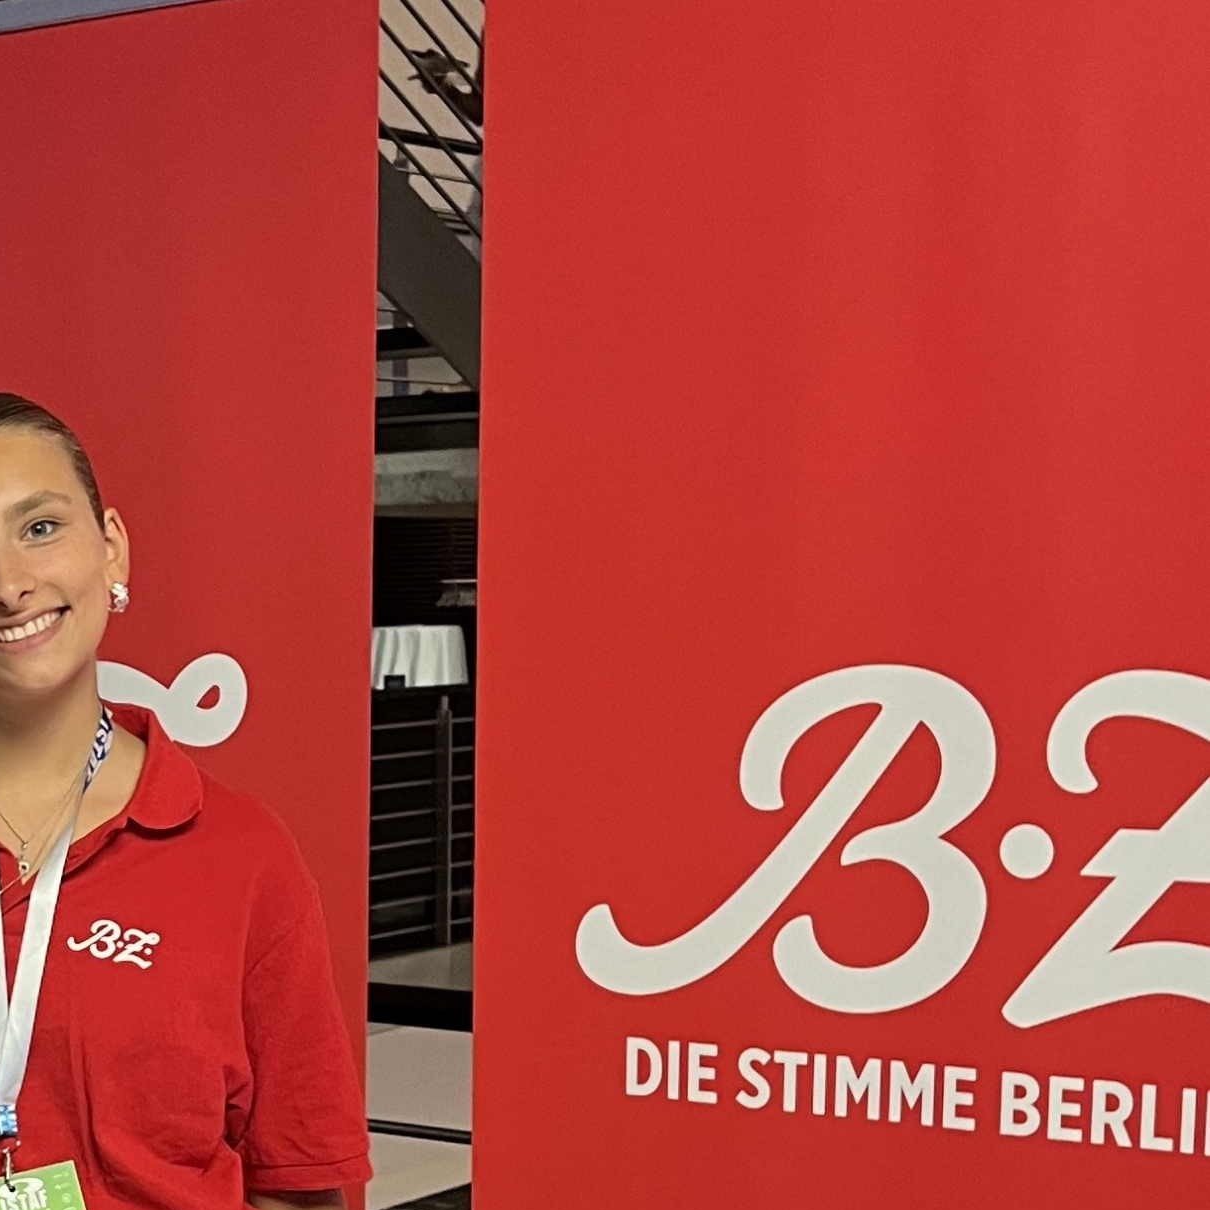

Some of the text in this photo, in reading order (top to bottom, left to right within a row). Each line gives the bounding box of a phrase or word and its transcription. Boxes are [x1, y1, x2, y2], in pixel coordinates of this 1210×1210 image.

[626, 1037, 1210, 1157] DIE STIMME BERLI
